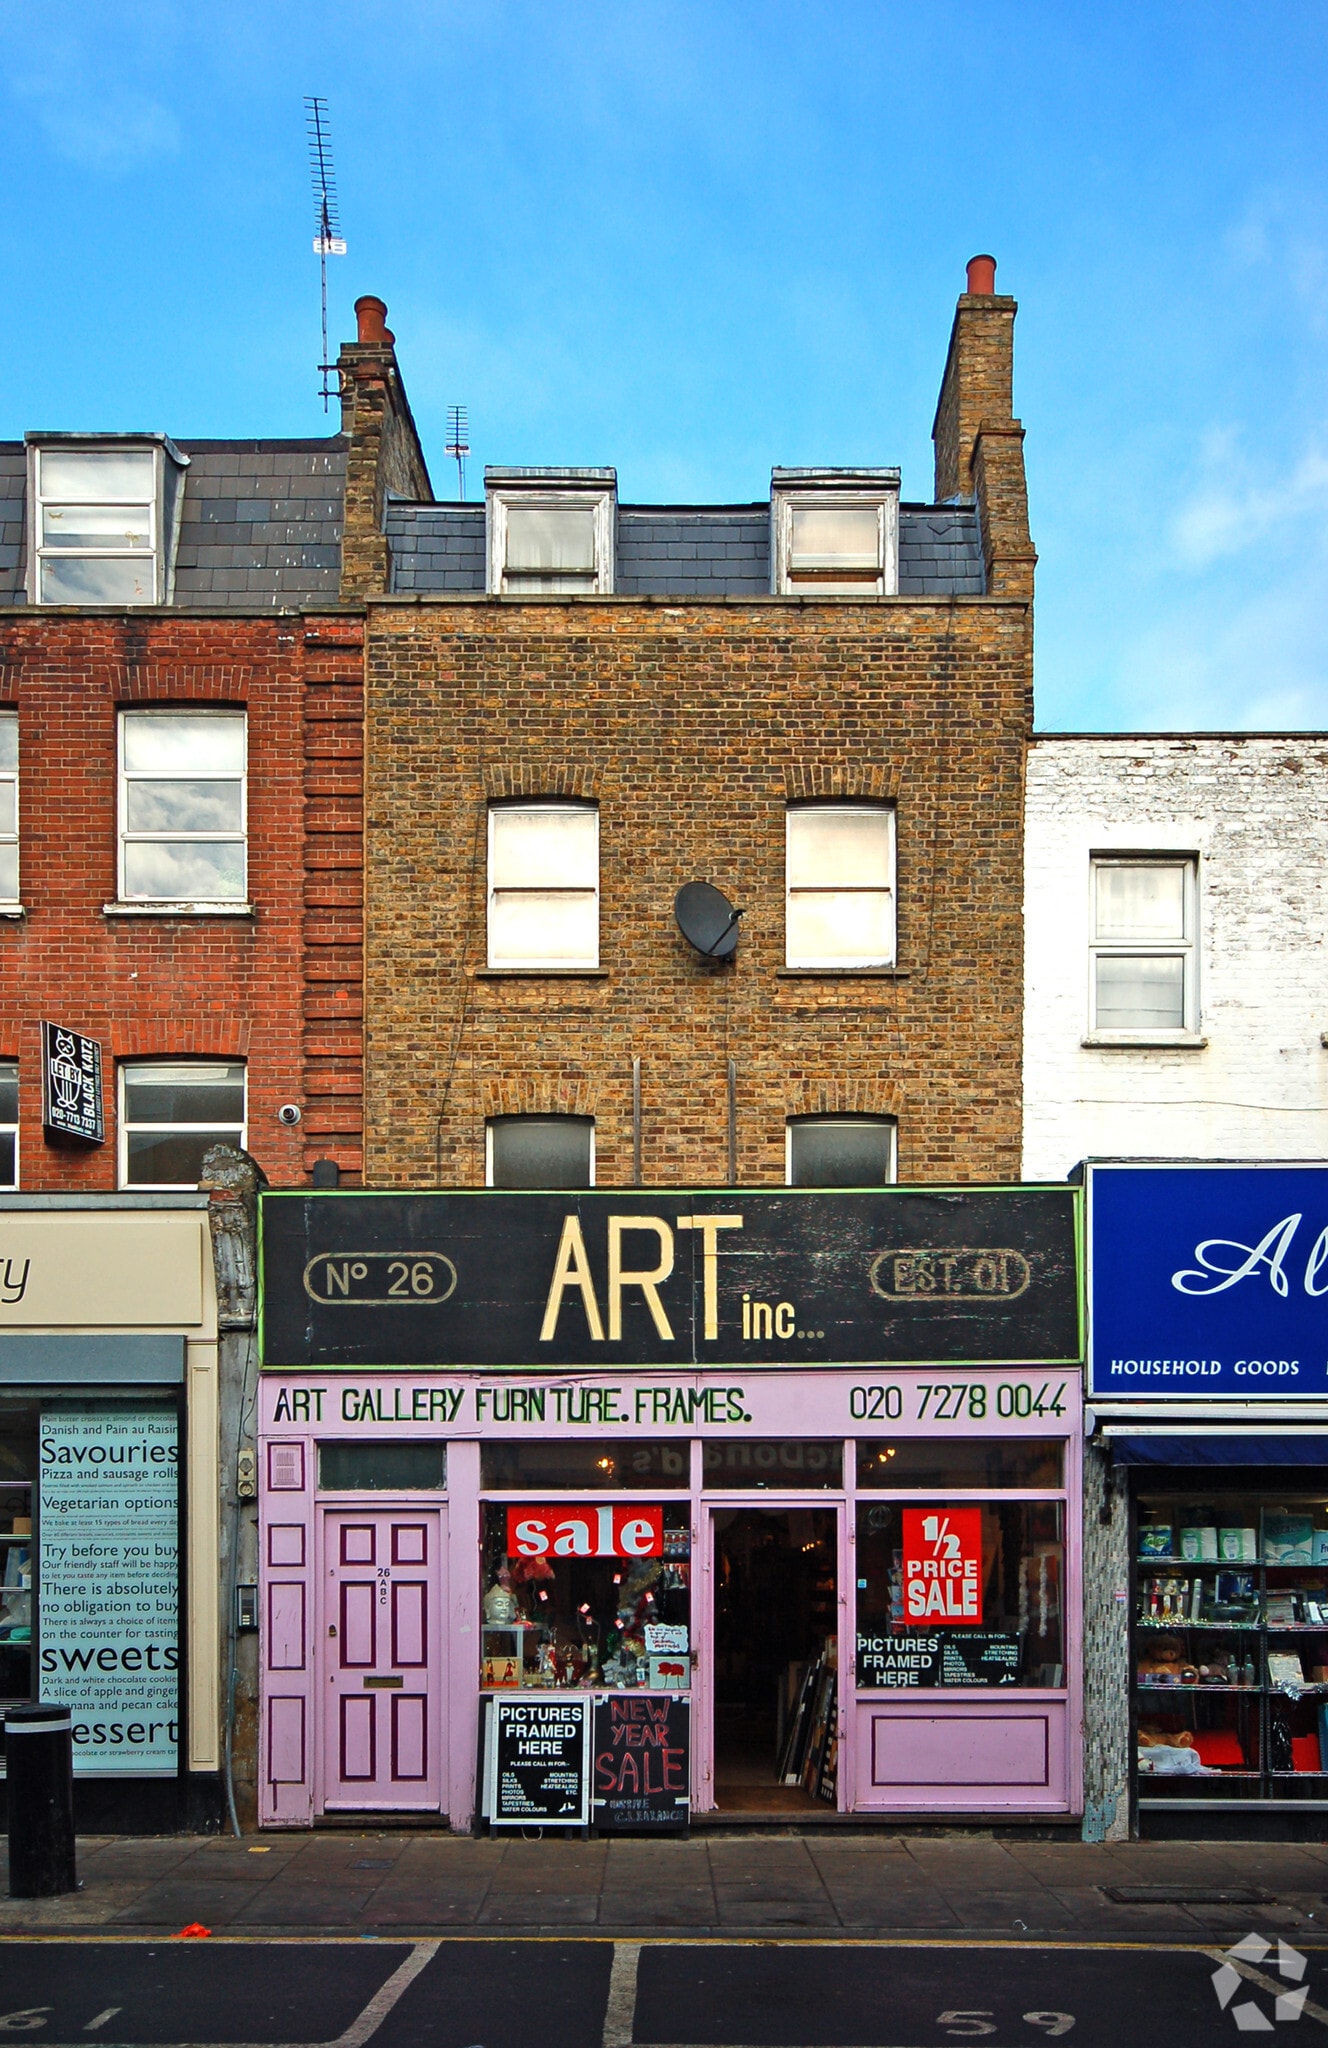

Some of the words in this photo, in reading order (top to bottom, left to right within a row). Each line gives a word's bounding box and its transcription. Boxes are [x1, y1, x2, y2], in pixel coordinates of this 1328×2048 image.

[81, 1038, 94, 1073] KATZ
[51, 1060, 66, 1078] LET
[70, 1066, 80, 1083] BY
[82, 1075, 95, 1118] BLACK
[0, 1257, 31, 1304] y
[386, 1261, 434, 1296] 26
[539, 1214, 744, 1342] ART
[1111, 1359, 1222, 1376] HOUSEHOLD
[1233, 1360, 1300, 1376] GOODS
[273, 1387, 327, 1423] ART
[341, 1387, 466, 1423] GALLERY
[850, 1386, 902, 1421] 020
[917, 1384, 987, 1420] 7278
[998, 1383, 1067, 1419] 0044
[42, 1424, 79, 1435] Danish
[83, 1424, 102, 1435] and
[106, 1424, 128, 1435] Pain
[132, 1424, 144, 1435] au
[41, 1438, 179, 1464] Savouries
[42, 1468, 73, 1479] Pizza
[77, 1468, 99, 1479] and
[103, 1471, 149, 1481] sausage
[153, 1468, 178, 1479] rolls
[42, 1496, 119, 1513] Vegetarian
[124, 1496, 178, 1513] options
[514, 1504, 655, 1556] sale
[42, 1543, 67, 1561] Try
[71, 1543, 118, 1557] before
[124, 1546, 149, 1560] you
[155, 1543, 178, 1560] buy
[42, 1560, 61, 1569] Our
[64, 1560, 97, 1569] friendly
[100, 1560, 119, 1569] staff
[122, 1560, 137, 1569] will
[140, 1560, 151, 1569] be
[153, 1560, 178, 1569] happy
[376, 1567, 391, 1578] 26
[907, 1560, 978, 1578] PRICE
[42, 1582, 86, 1595] There
[91, 1582, 102, 1595] is
[106, 1581, 178, 1598] absolutely
[380, 1588, 387, 1596] B
[908, 1578, 978, 1617] SALE
[42, 1602, 59, 1612] no
[63, 1600, 131, 1615] obligation
[136, 1600, 150, 1612] to
[156, 1599, 178, 1615] buy
[379, 1596, 387, 1605] C
[79, 1617, 106, 1627] always
[116, 1617, 143, 1625] choice
[146, 1616, 155, 1625] of
[42, 1631, 55, 1639] on
[60, 1629, 77, 1639] the
[80, 1629, 122, 1639] counter
[125, 1628, 141, 1638] for
[145, 1629, 178, 1639] tasting
[857, 1638, 939, 1652] PICTURES
[41, 1643, 178, 1672] sweets
[863, 1654, 933, 1669] FRAMED
[42, 1676, 62, 1684] Dark
[65, 1676, 80, 1684] and
[82, 1676, 105, 1684] white
[107, 1676, 147, 1684] chocolate
[875, 1671, 919, 1685] HERE
[42, 1687, 51, 1696] A
[54, 1687, 77, 1696] slice
[80, 1687, 91, 1696] of
[94, 1686, 122, 1698] apple
[125, 1686, 144, 1696] and
[147, 1687, 178, 1698] ginger
[98, 1701, 118, 1710] and
[121, 1701, 152, 1712] pecan
[156, 1699, 178, 1709] cake
[610, 1698, 671, 1723] NEW
[500, 1707, 582, 1722] PICTURES
[71, 1719, 178, 1744] essert
[506, 1724, 577, 1738] FRAMED
[610, 1723, 671, 1748] YEAR
[109, 1749, 144, 1757] strawberry
[518, 1740, 563, 1755] HERE
[595, 1748, 685, 1794] SALE
